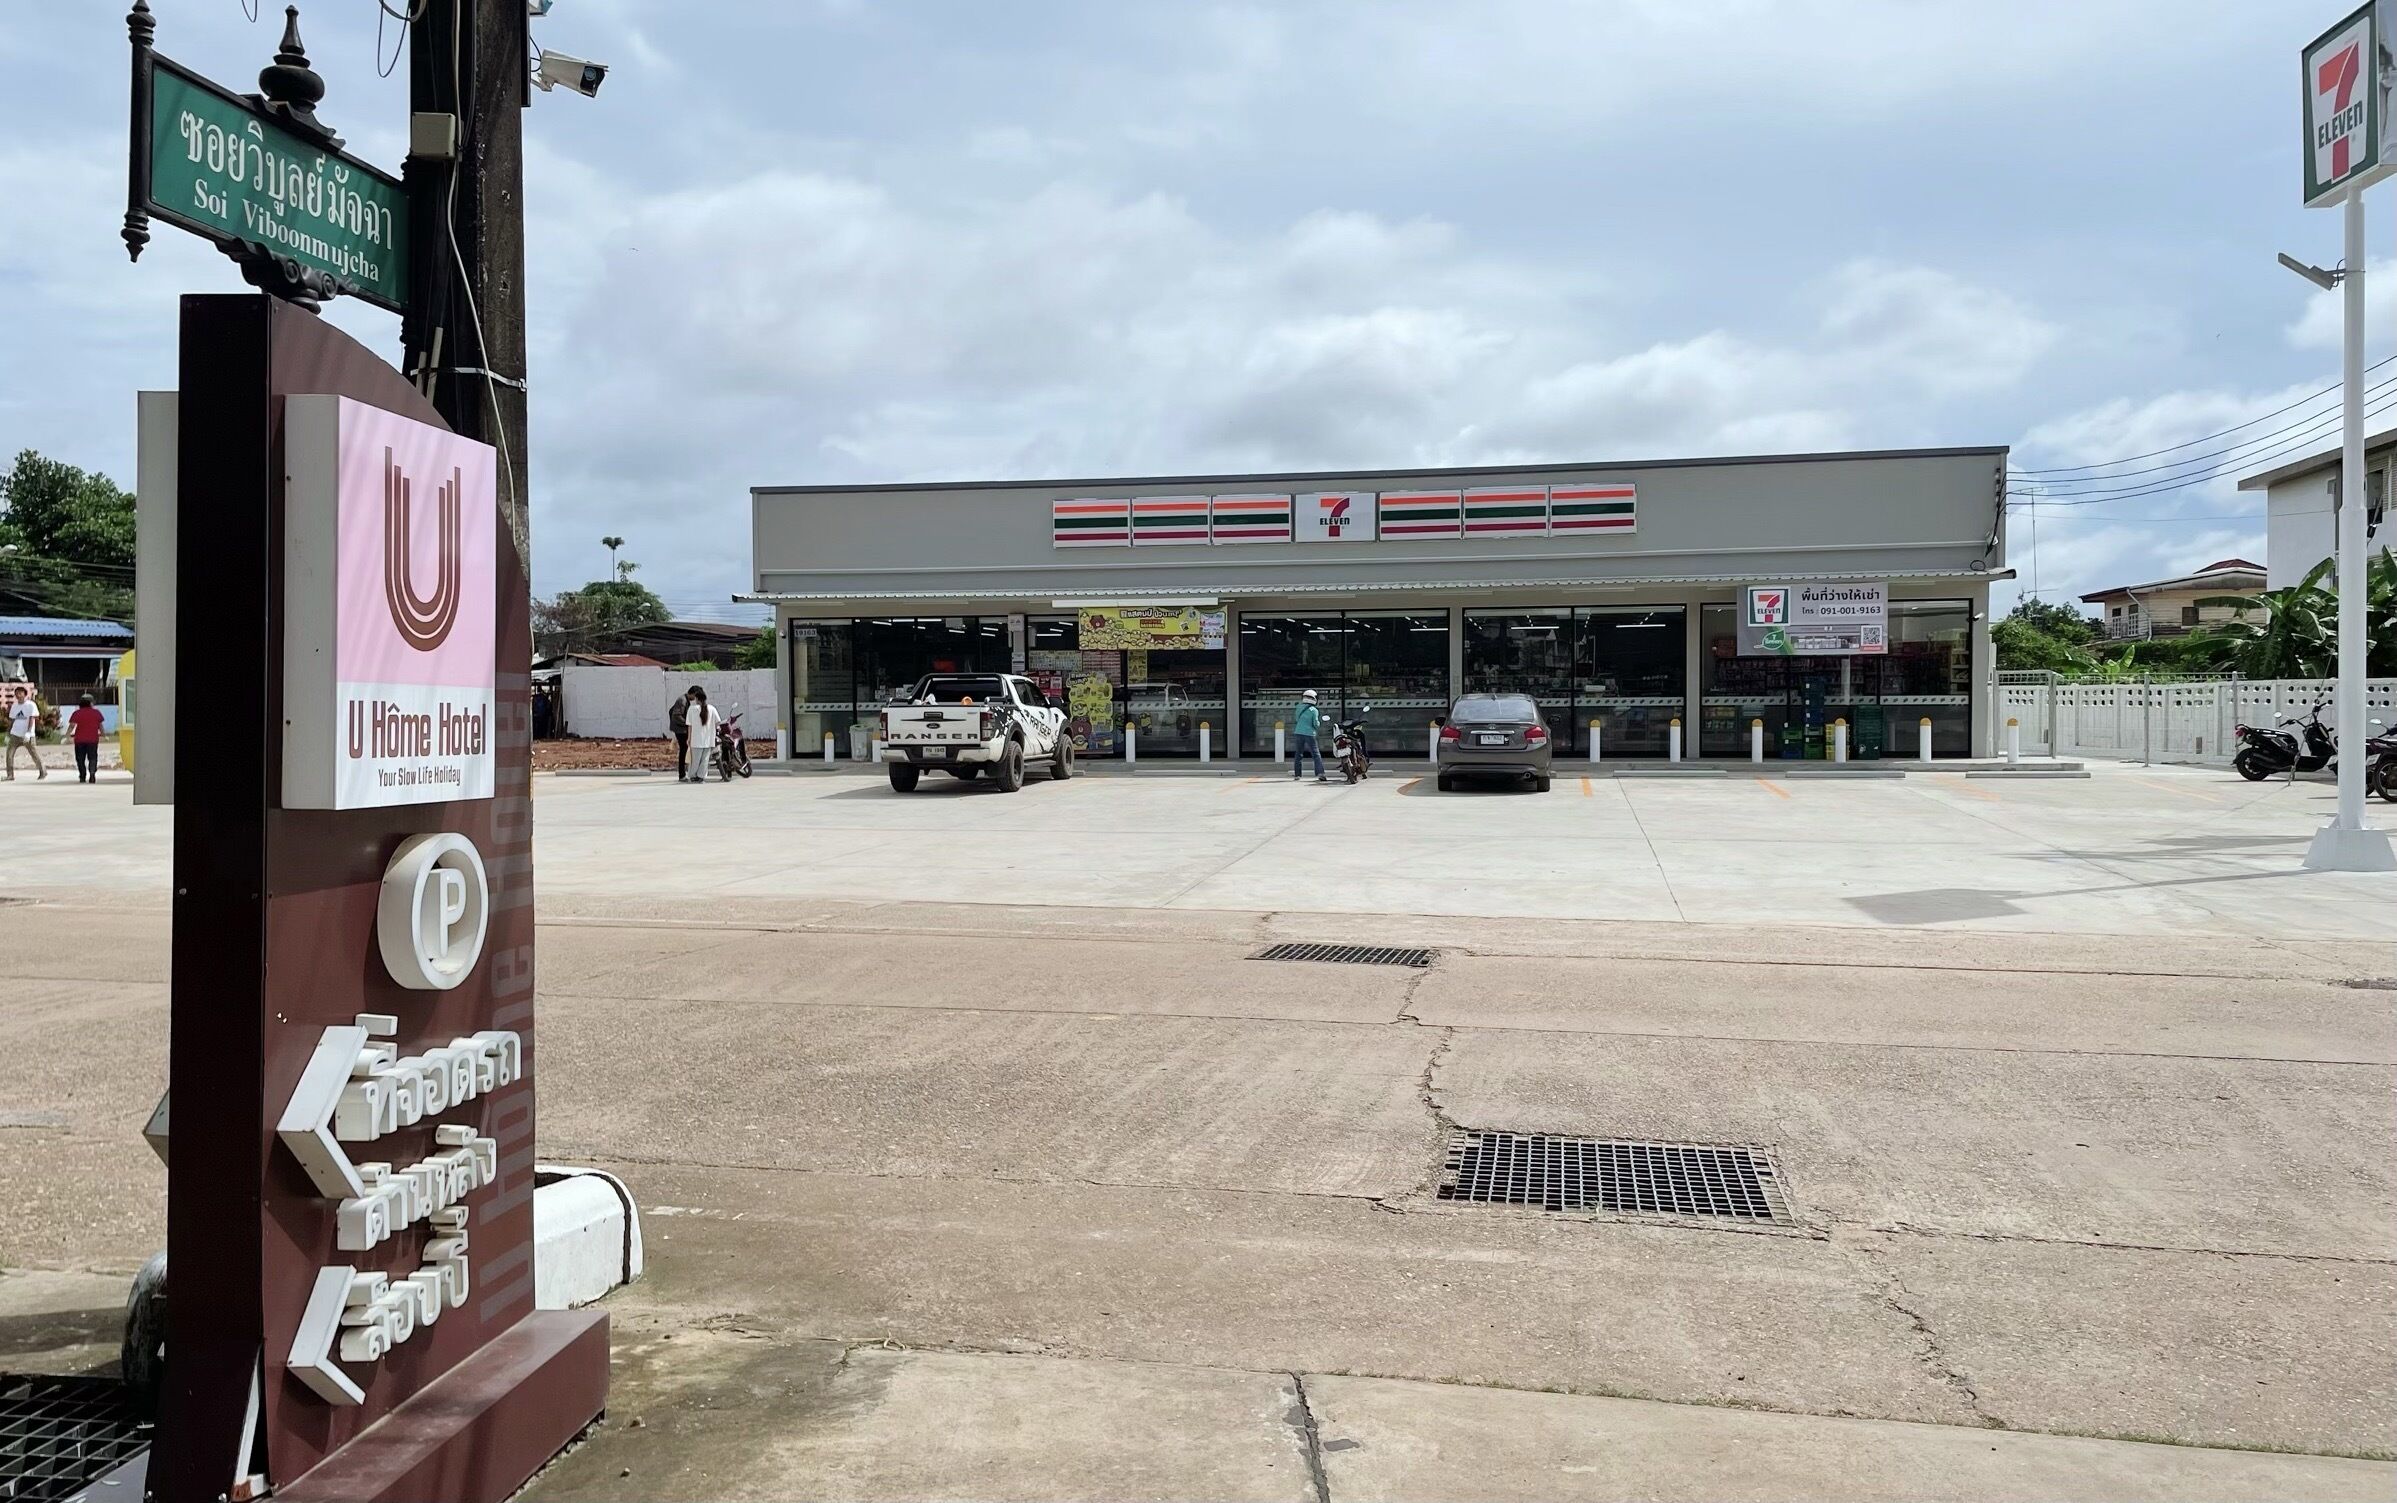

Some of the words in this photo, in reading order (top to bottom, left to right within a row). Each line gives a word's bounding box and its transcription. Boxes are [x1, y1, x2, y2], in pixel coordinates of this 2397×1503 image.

[2319, 41, 2360, 180] 7
[194, 178, 228, 219] Soi
[242, 198, 379, 282] Viboonmujcha
[1320, 497, 1350, 537] 7
[1758, 594, 1781, 623] 7
[1802, 586, 1880, 602] พื้นที่ว่างให้เช่า
[1820, 606, 1881, 615] 091-001-9163
[349, 700, 364, 758] U
[371, 700, 431, 758] Hôme
[438, 702, 486, 756] Hotel
[378, 769, 397, 787] Your
[398, 767, 416, 786] Slow
[418, 766, 433, 784] Life
[434, 765, 461, 786] Holiday
[430, 868, 467, 957] P
[335, 1013, 521, 1141] ที่จอดรถ
[337, 1124, 497, 1251] ด้านหลัง
